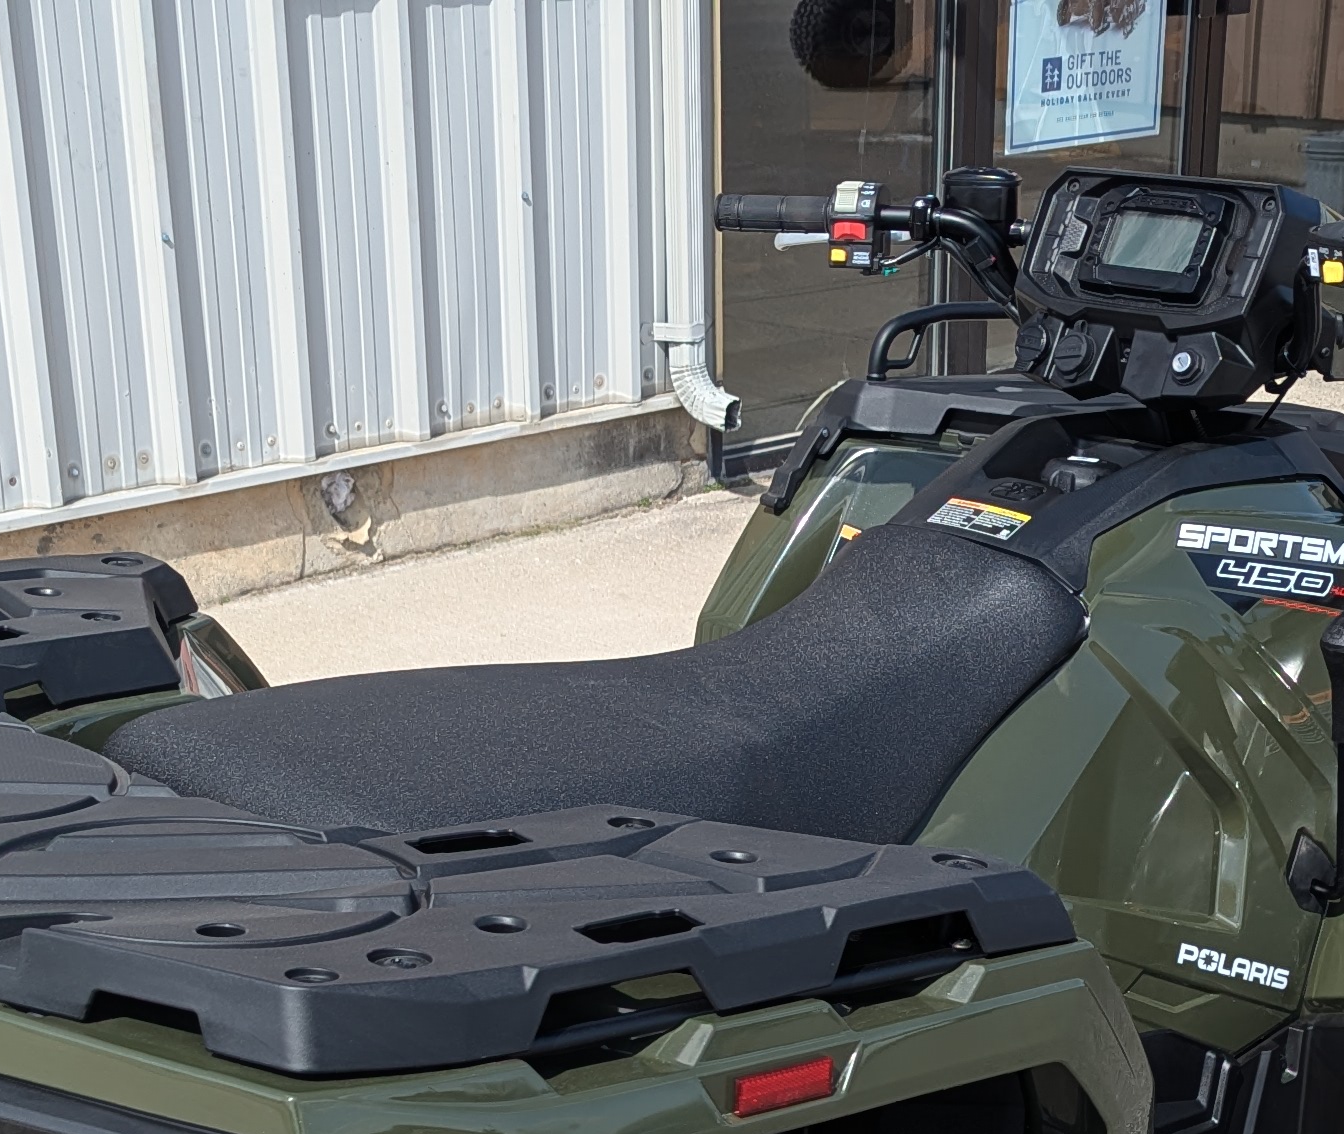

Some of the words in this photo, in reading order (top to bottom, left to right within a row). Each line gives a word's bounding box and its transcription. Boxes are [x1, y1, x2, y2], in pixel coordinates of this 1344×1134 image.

[1067, 52, 1095, 71] GIFT
[1099, 49, 1122, 67] THE
[1066, 67, 1132, 90] OUTDOORS
[1040, 95, 1074, 107] HOLIDAY
[1078, 91, 1103, 102] SALES
[1106, 88, 1131, 99] EVENT
[1216, 558, 1335, 598] 450
[1176, 942, 1291, 990] POLARIS
